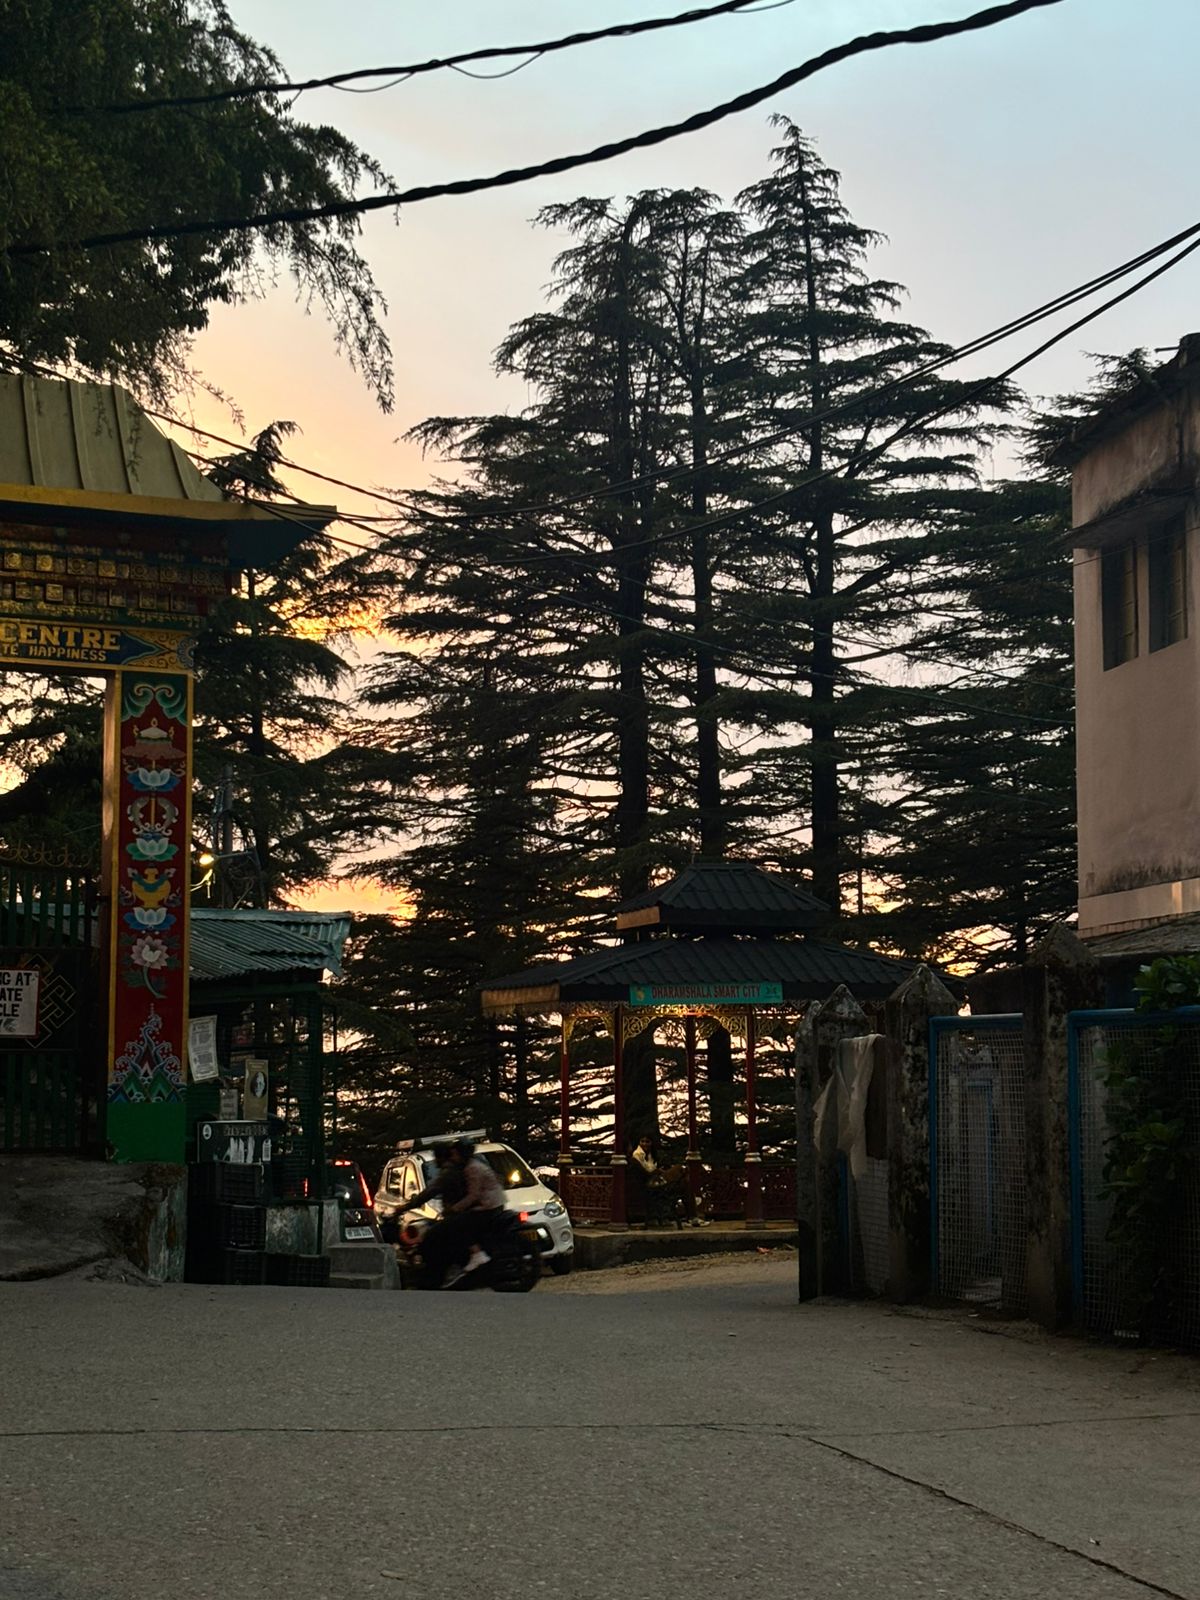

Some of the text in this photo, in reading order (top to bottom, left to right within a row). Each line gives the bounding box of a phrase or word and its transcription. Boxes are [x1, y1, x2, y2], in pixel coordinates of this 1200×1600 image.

[0, 623, 120, 650] CENTRE
[0, 642, 107, 662] TE HAPPINESS
[15, 972, 32, 986] AT
[652, 984, 761, 999] DHARAMSHALA SMART CITY
